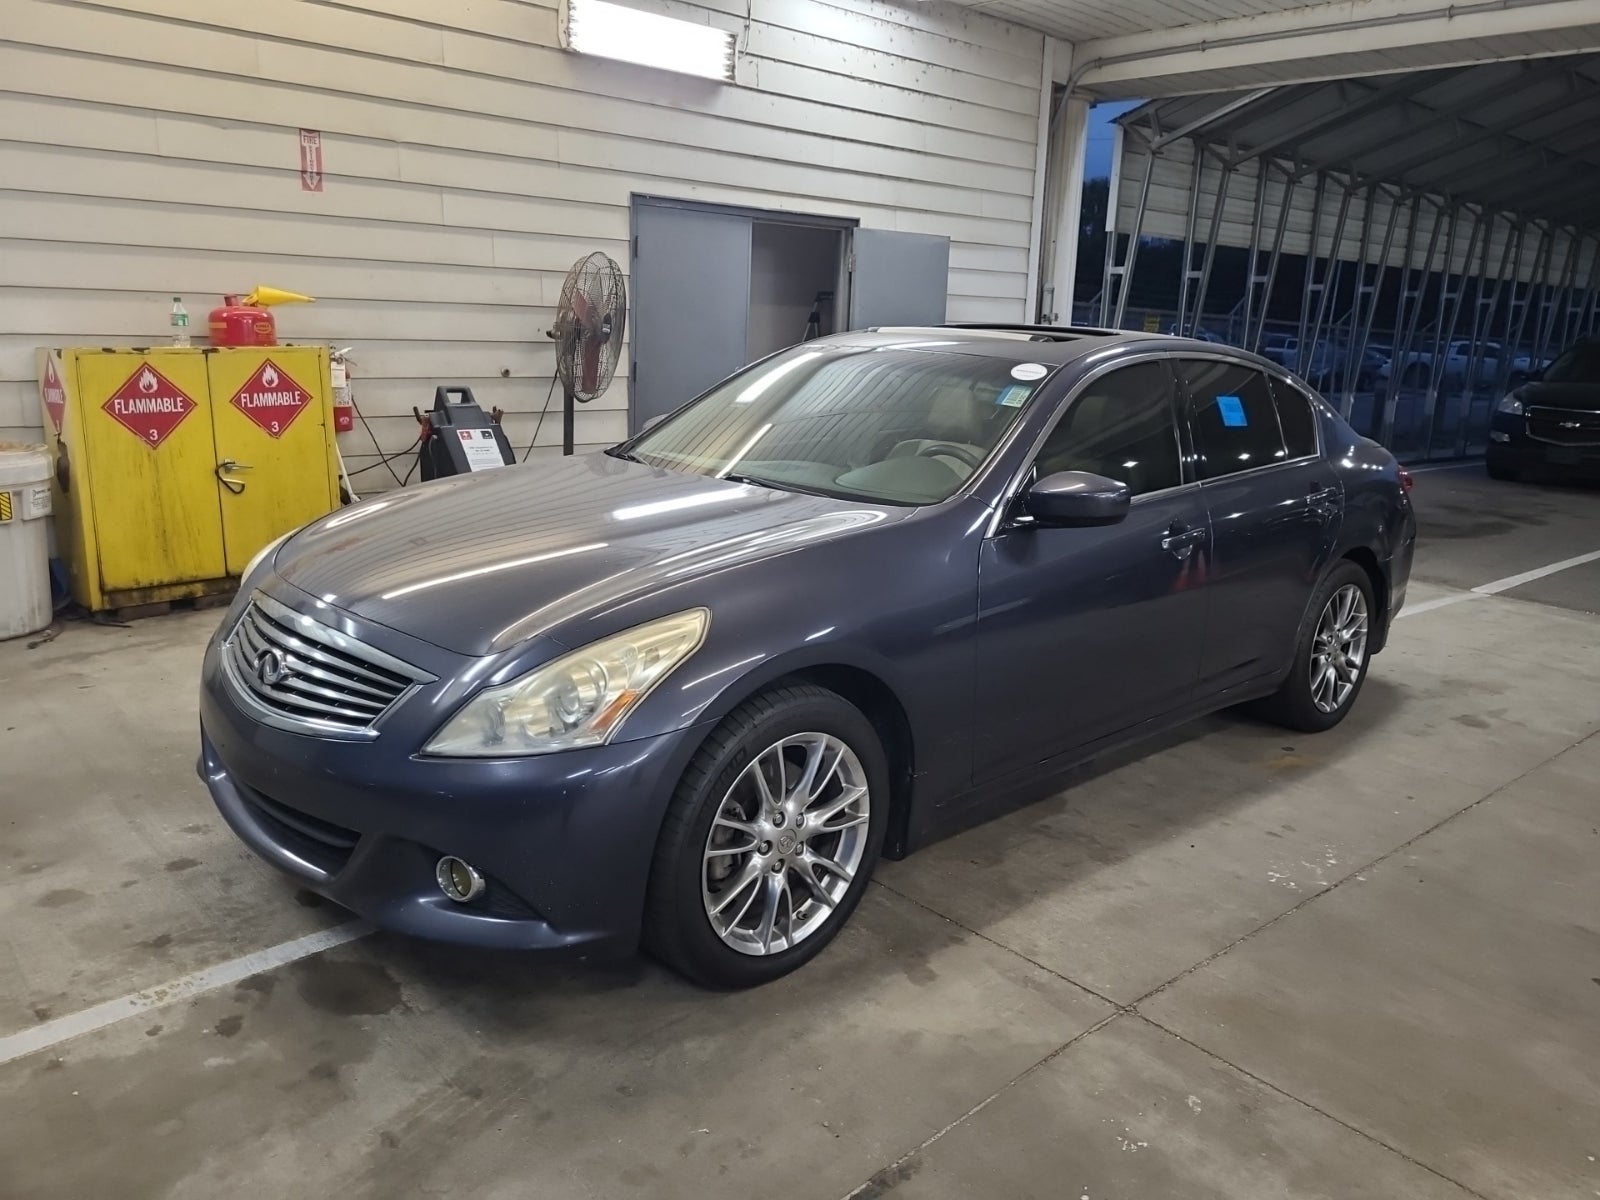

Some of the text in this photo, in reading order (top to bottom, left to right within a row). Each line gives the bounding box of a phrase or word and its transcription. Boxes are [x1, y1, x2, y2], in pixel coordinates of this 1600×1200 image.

[303, 135, 318, 145] FIRE
[114, 397, 185, 414] FLAMMABLE
[242, 391, 302, 408] FLAMMABLE
[271, 421, 280, 433] 3
[149, 429, 159, 441] 3
